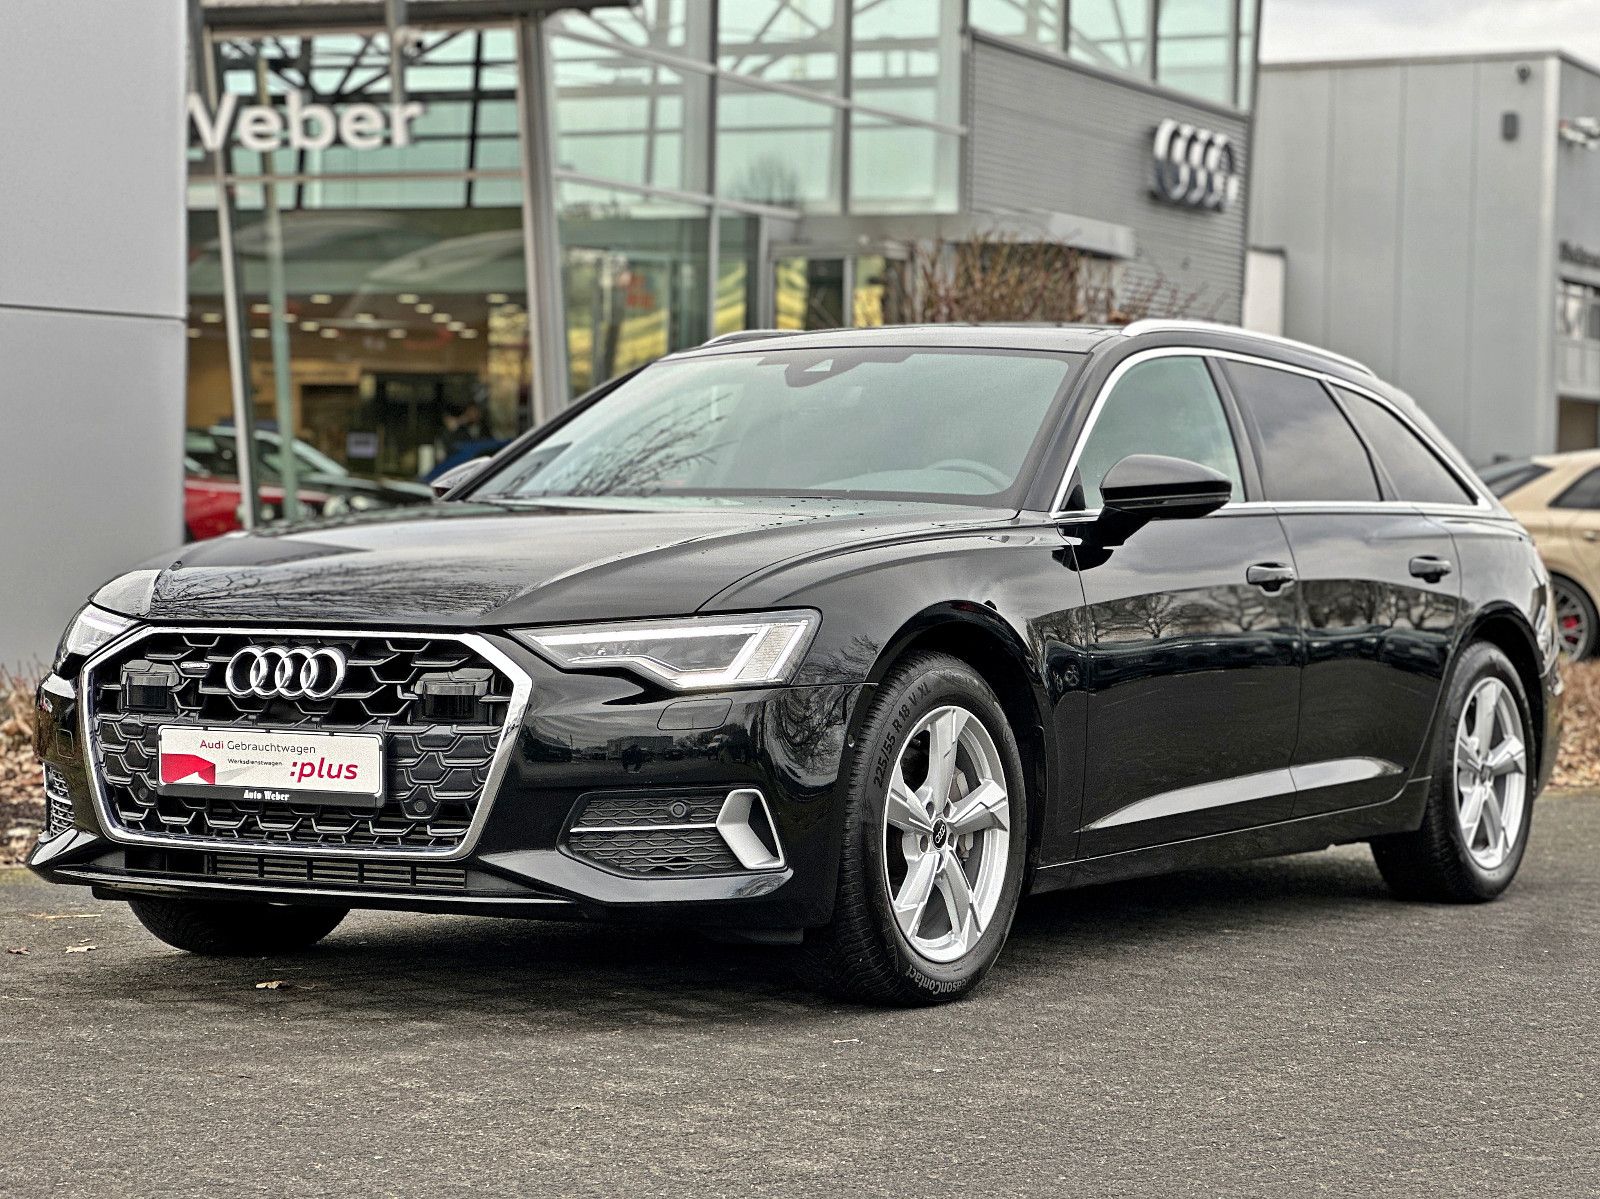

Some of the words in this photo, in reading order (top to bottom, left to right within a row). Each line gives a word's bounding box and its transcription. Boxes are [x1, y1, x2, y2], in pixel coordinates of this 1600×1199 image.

[200, 739, 224, 750] Audi
[227, 740, 316, 756] Gebrauchtwagen
[873, 731, 896, 789] 225/55
[892, 719, 903, 734] R
[898, 704, 911, 721] 18
[227, 758, 283, 767] Werksdienstwagen
[289, 757, 359, 784] :plus
[243, 789, 262, 800] Auto
[264, 790, 290, 801] Weber
